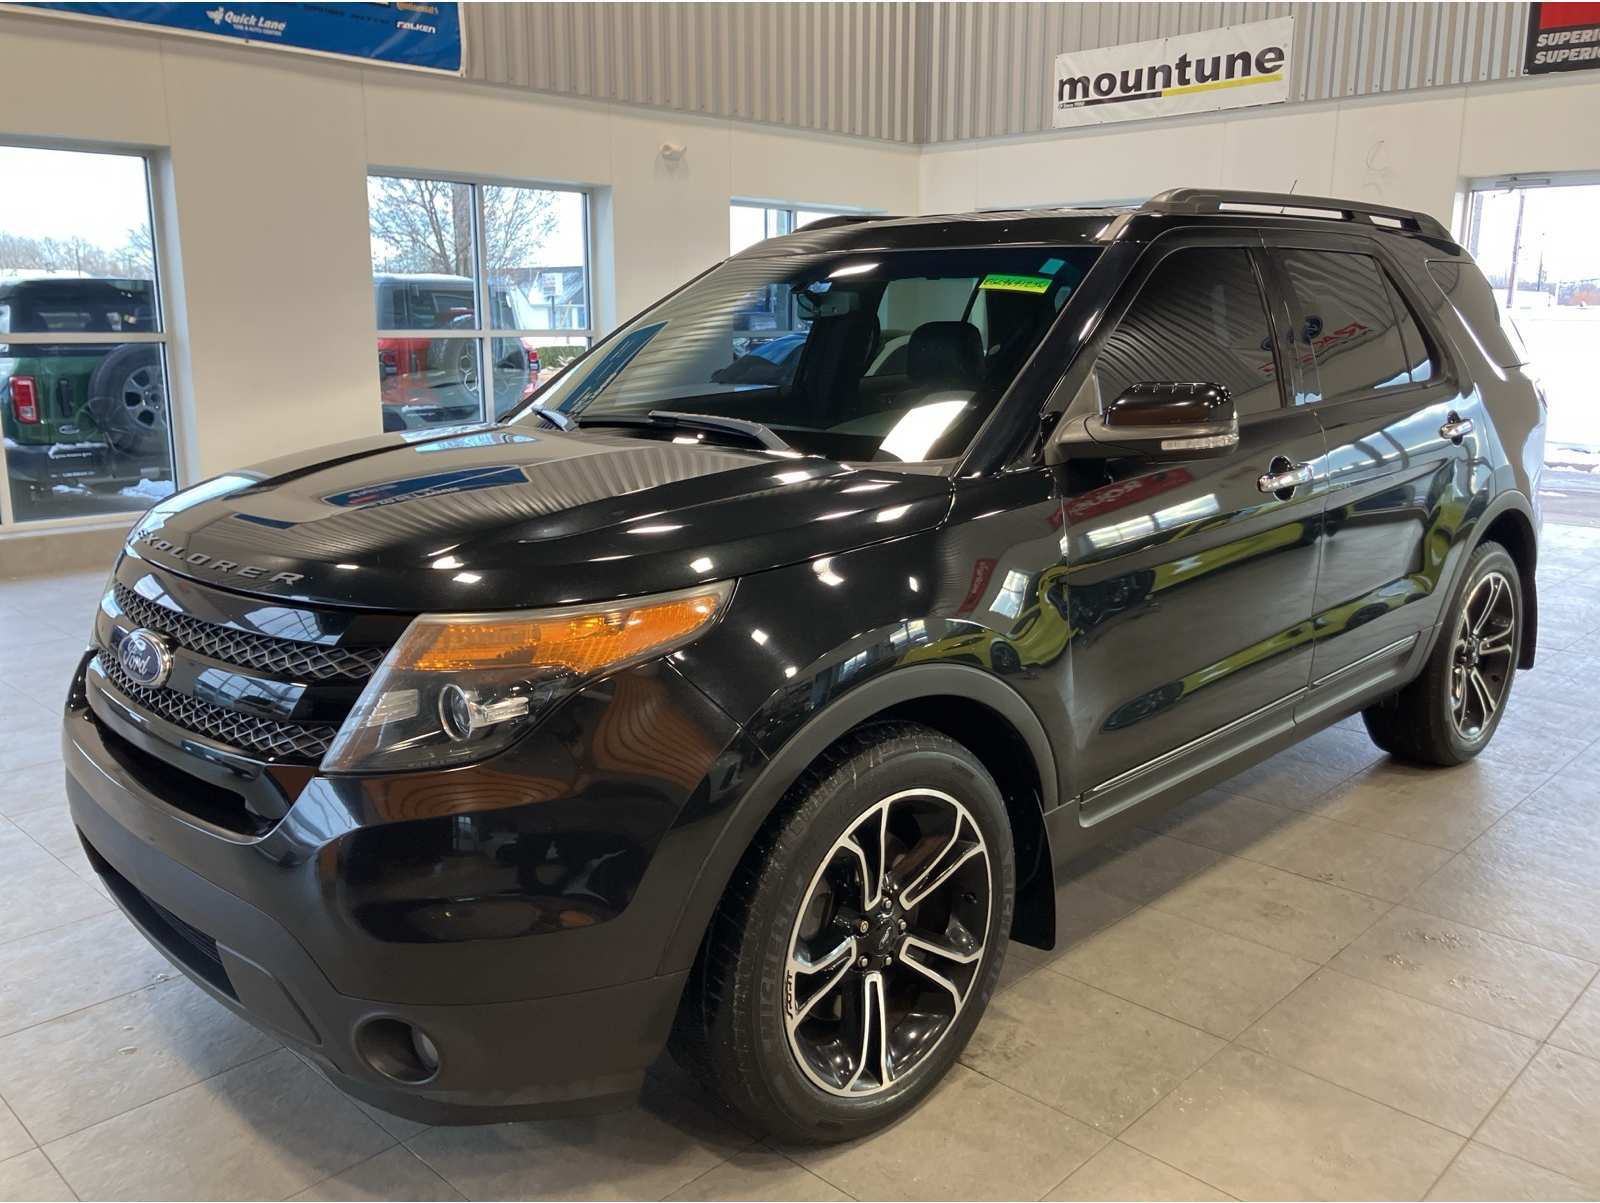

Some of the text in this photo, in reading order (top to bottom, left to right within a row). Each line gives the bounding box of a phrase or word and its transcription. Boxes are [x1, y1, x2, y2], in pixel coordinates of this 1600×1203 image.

[225, 11, 257, 26] Quick
[258, 16, 287, 32] Lane
[1537, 28, 1600, 48] SUPERI
[1058, 46, 1285, 101] mountune
